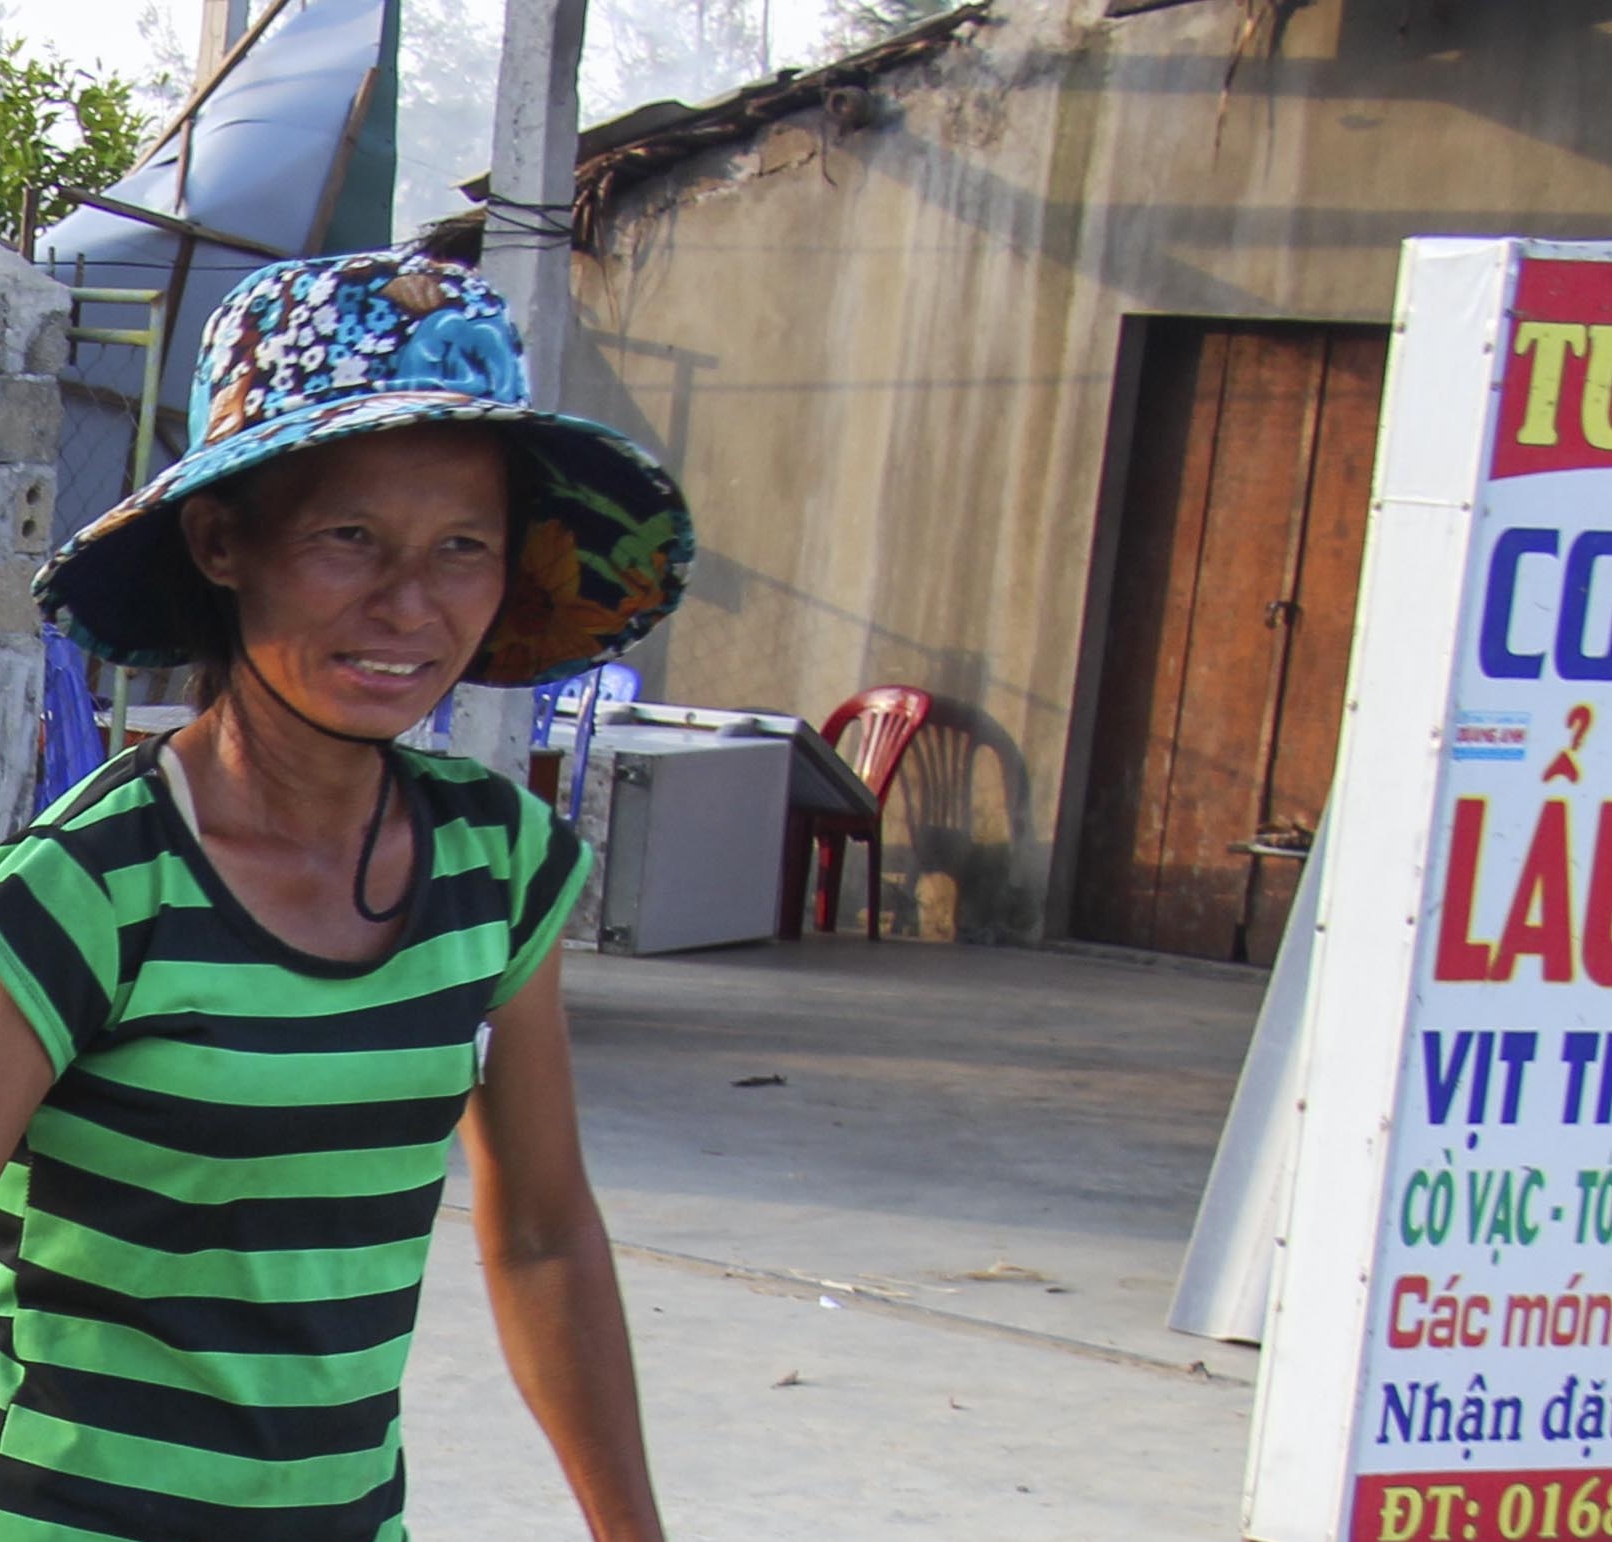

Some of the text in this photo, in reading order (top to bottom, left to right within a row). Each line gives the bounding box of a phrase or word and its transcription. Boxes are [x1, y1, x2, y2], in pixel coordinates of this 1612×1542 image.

[1422, 1030, 1538, 1150] VỊT
[1399, 1148, 1455, 1247] CÒ
[1467, 1165, 1545, 1266] VẠC
[1387, 1272, 1612, 1350] Các món
[1375, 1373, 1612, 1460] Nhận đặ
[1377, 1485, 1480, 1542] ĐT:
